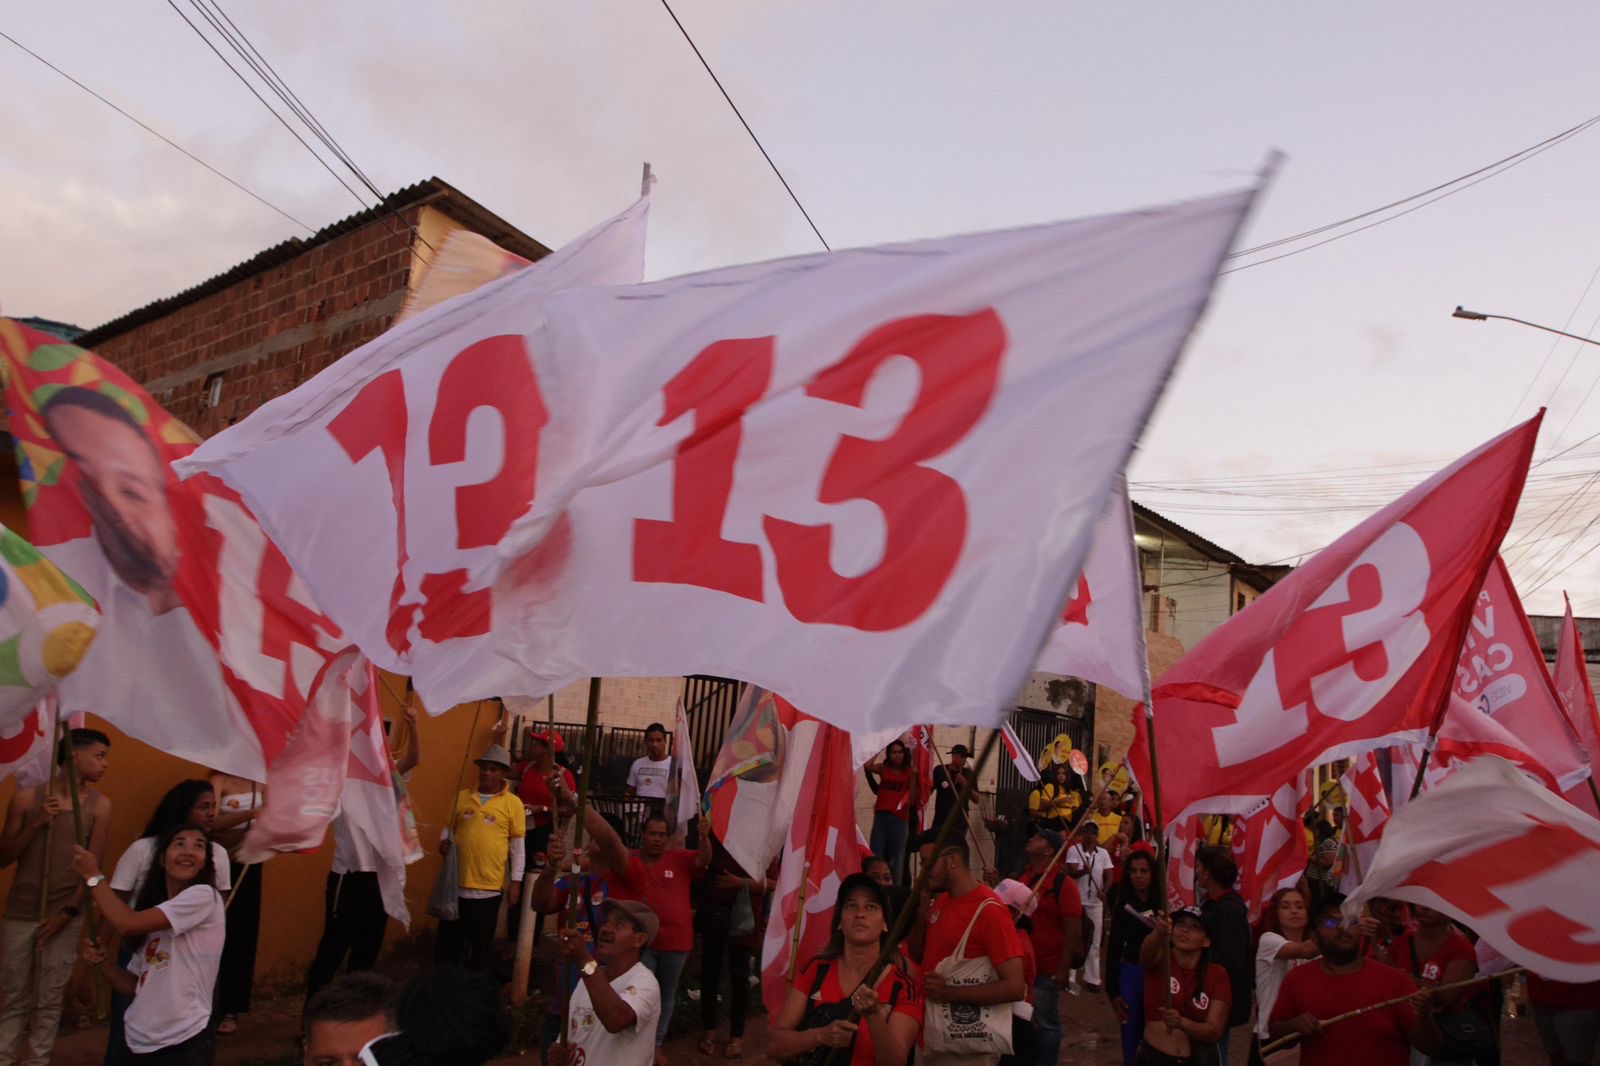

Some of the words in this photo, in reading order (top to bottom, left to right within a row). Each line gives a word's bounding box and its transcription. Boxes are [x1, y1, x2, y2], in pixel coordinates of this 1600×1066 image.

[632, 306, 1010, 632] 13
[1211, 520, 1431, 768] 13
[1422, 962, 1440, 980] 13
